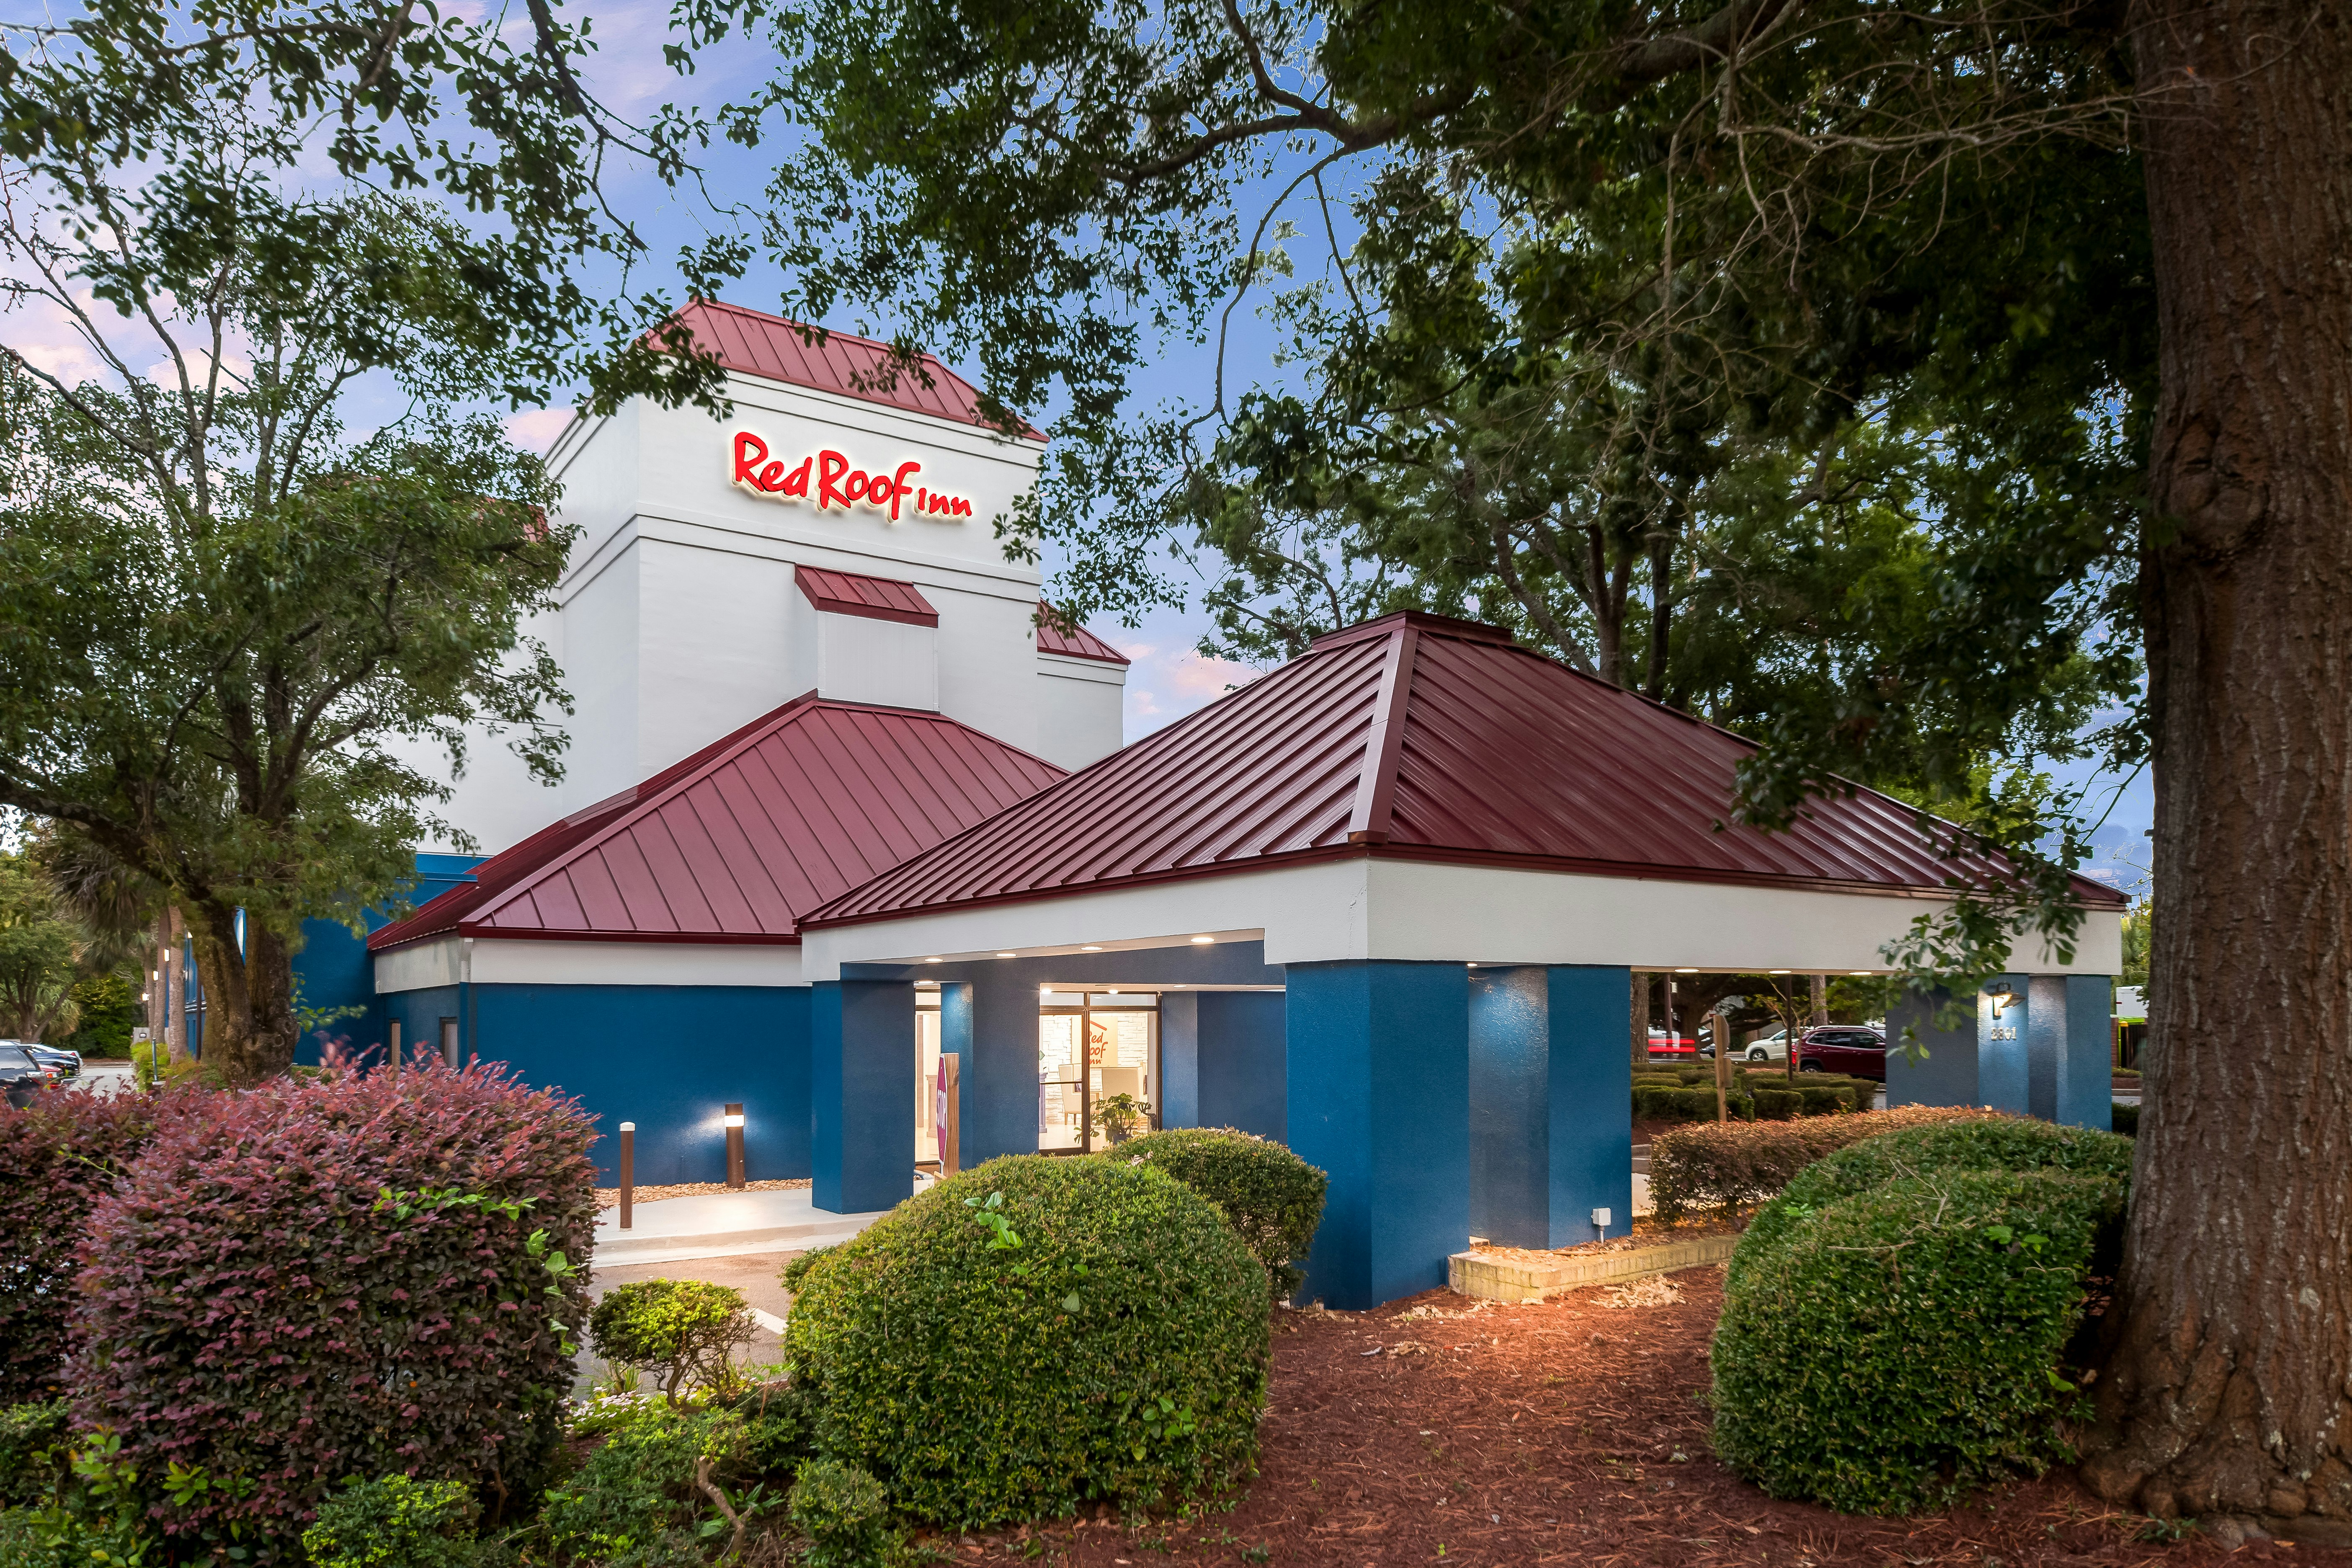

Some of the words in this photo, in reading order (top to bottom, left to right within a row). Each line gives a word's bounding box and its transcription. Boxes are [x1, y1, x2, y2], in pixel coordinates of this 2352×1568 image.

[733, 431, 813, 498] Red
[818, 449, 921, 521] Roof
[1089, 1042, 1108, 1058] oof
[936, 1089, 946, 1130] STOP
